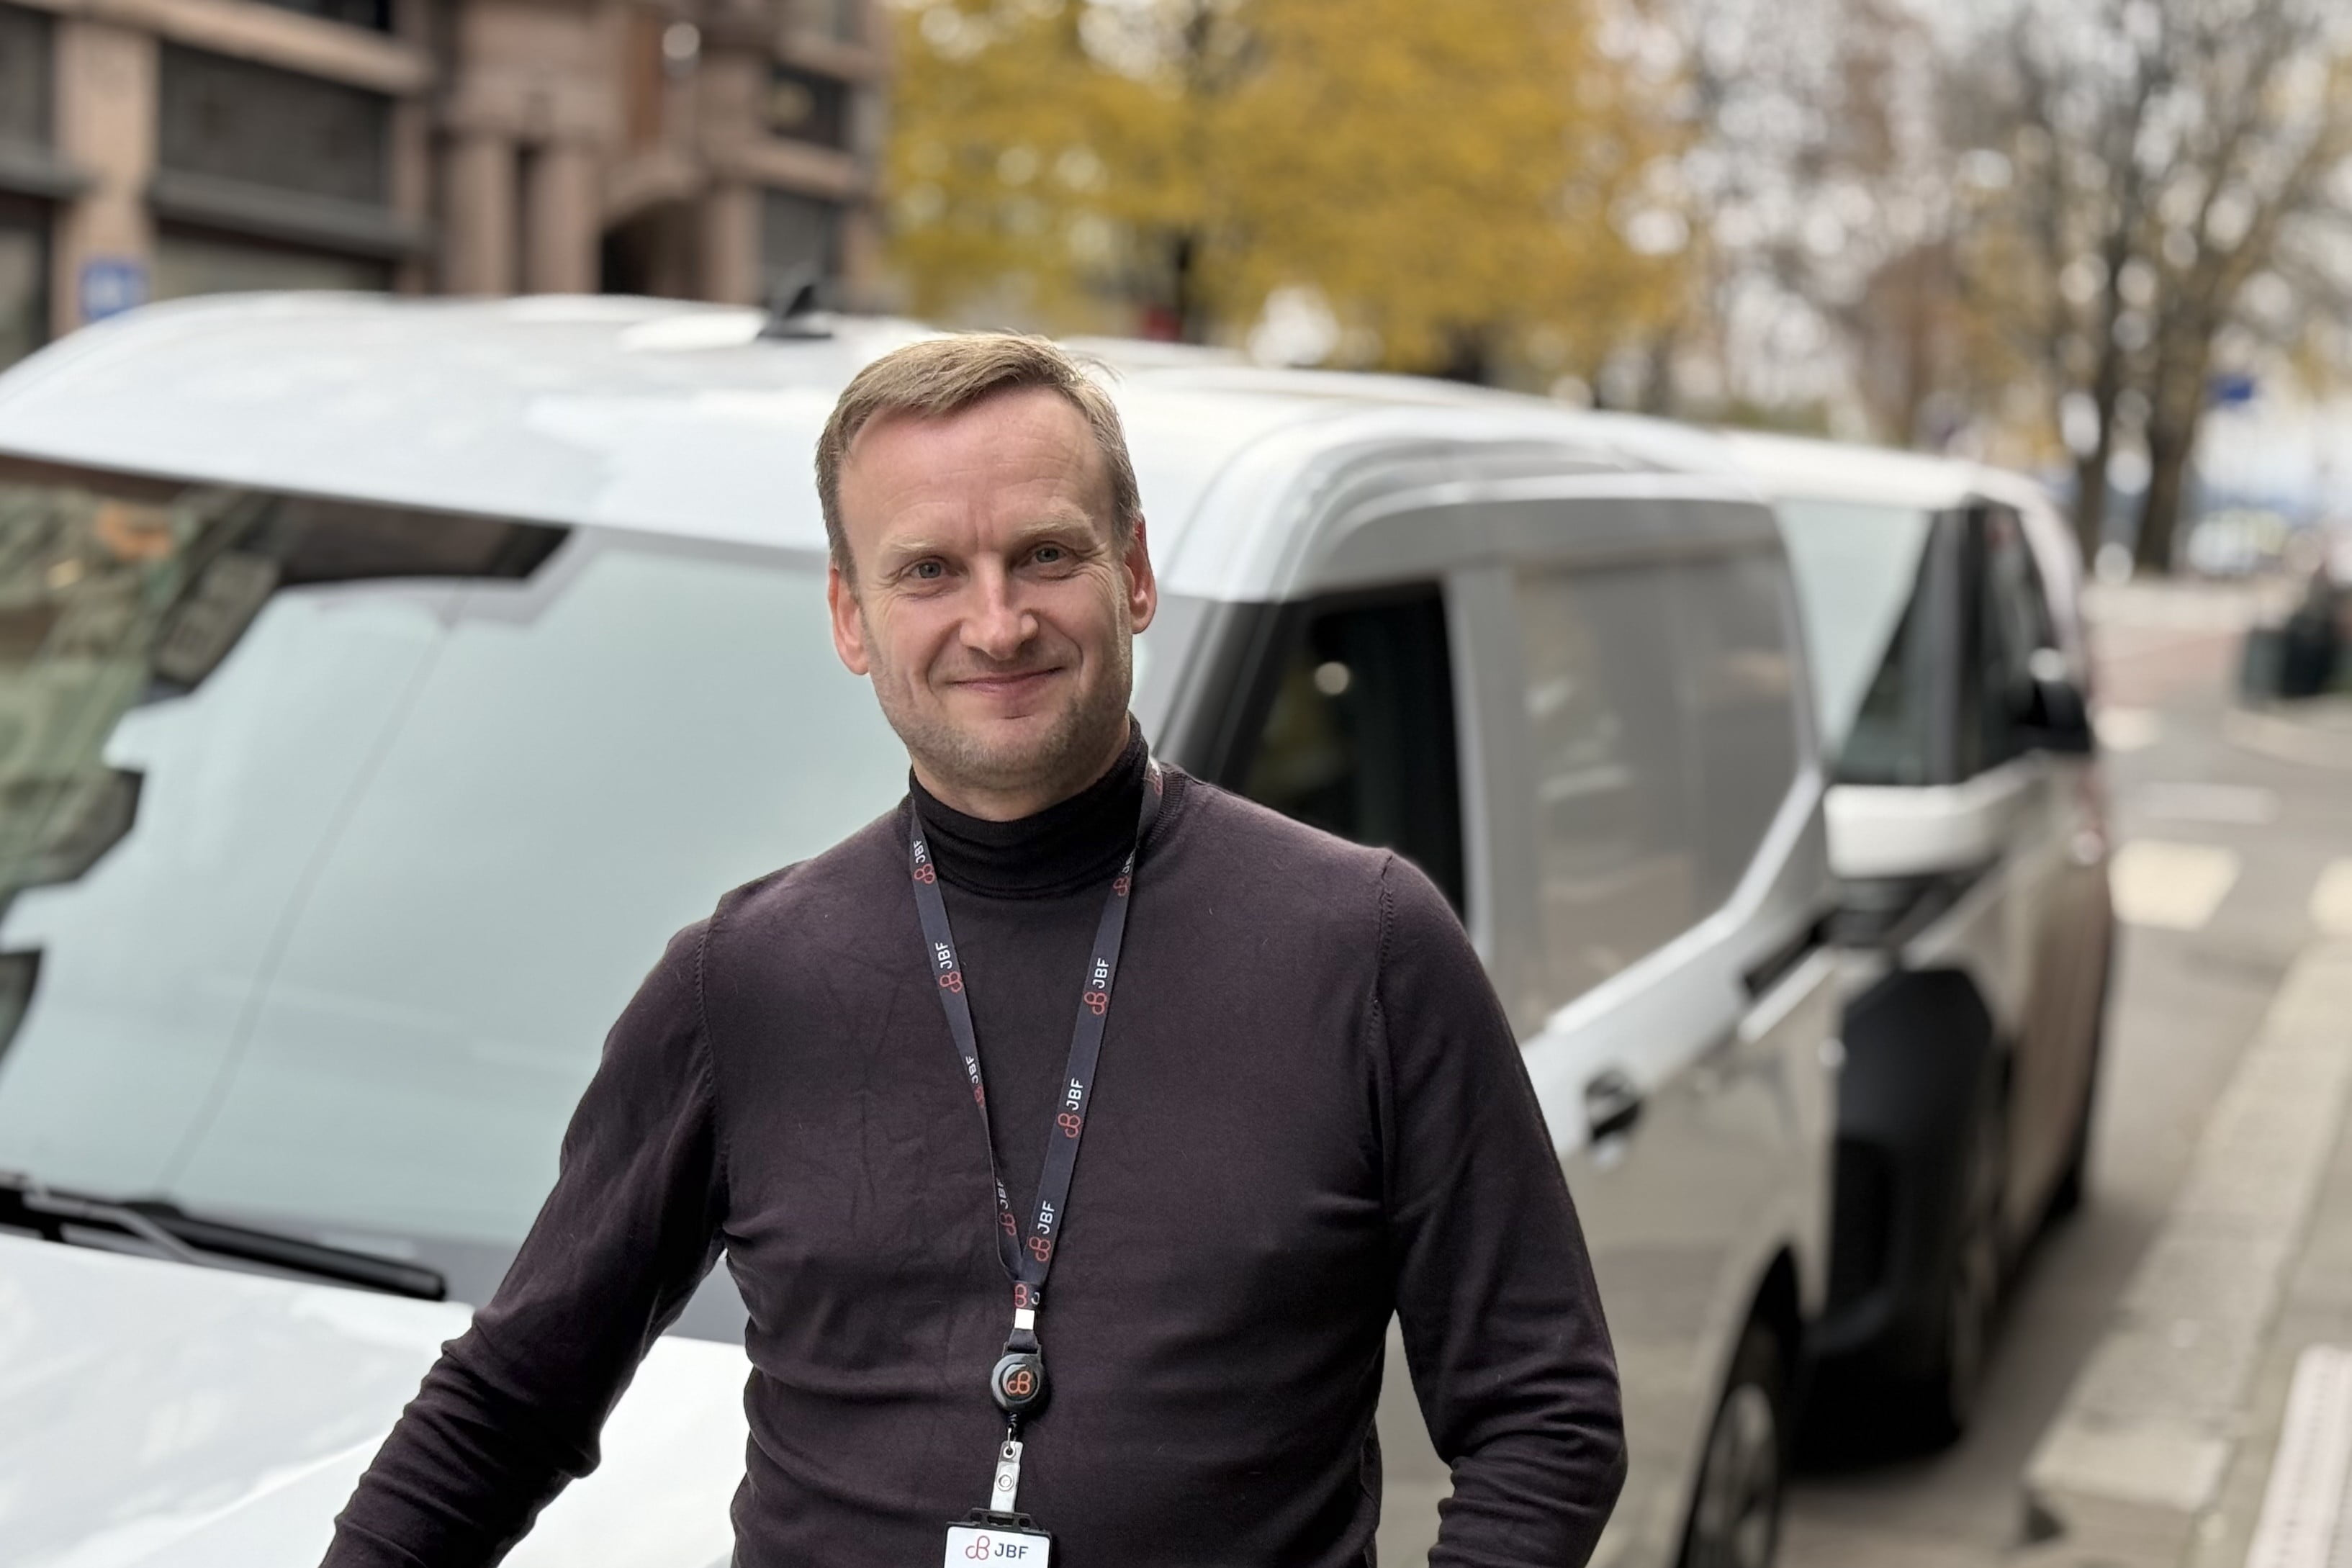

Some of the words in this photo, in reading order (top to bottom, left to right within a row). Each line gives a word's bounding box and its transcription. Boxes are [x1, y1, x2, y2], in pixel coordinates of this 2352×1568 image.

[914, 840, 926, 864] JBF
[935, 942, 953, 969] JBF
[1093, 958, 1109, 988] JBF
[1066, 1078, 1083, 1111] JBF
[1037, 1200, 1055, 1235] JBF
[995, 1543, 1029, 1559] JBF
